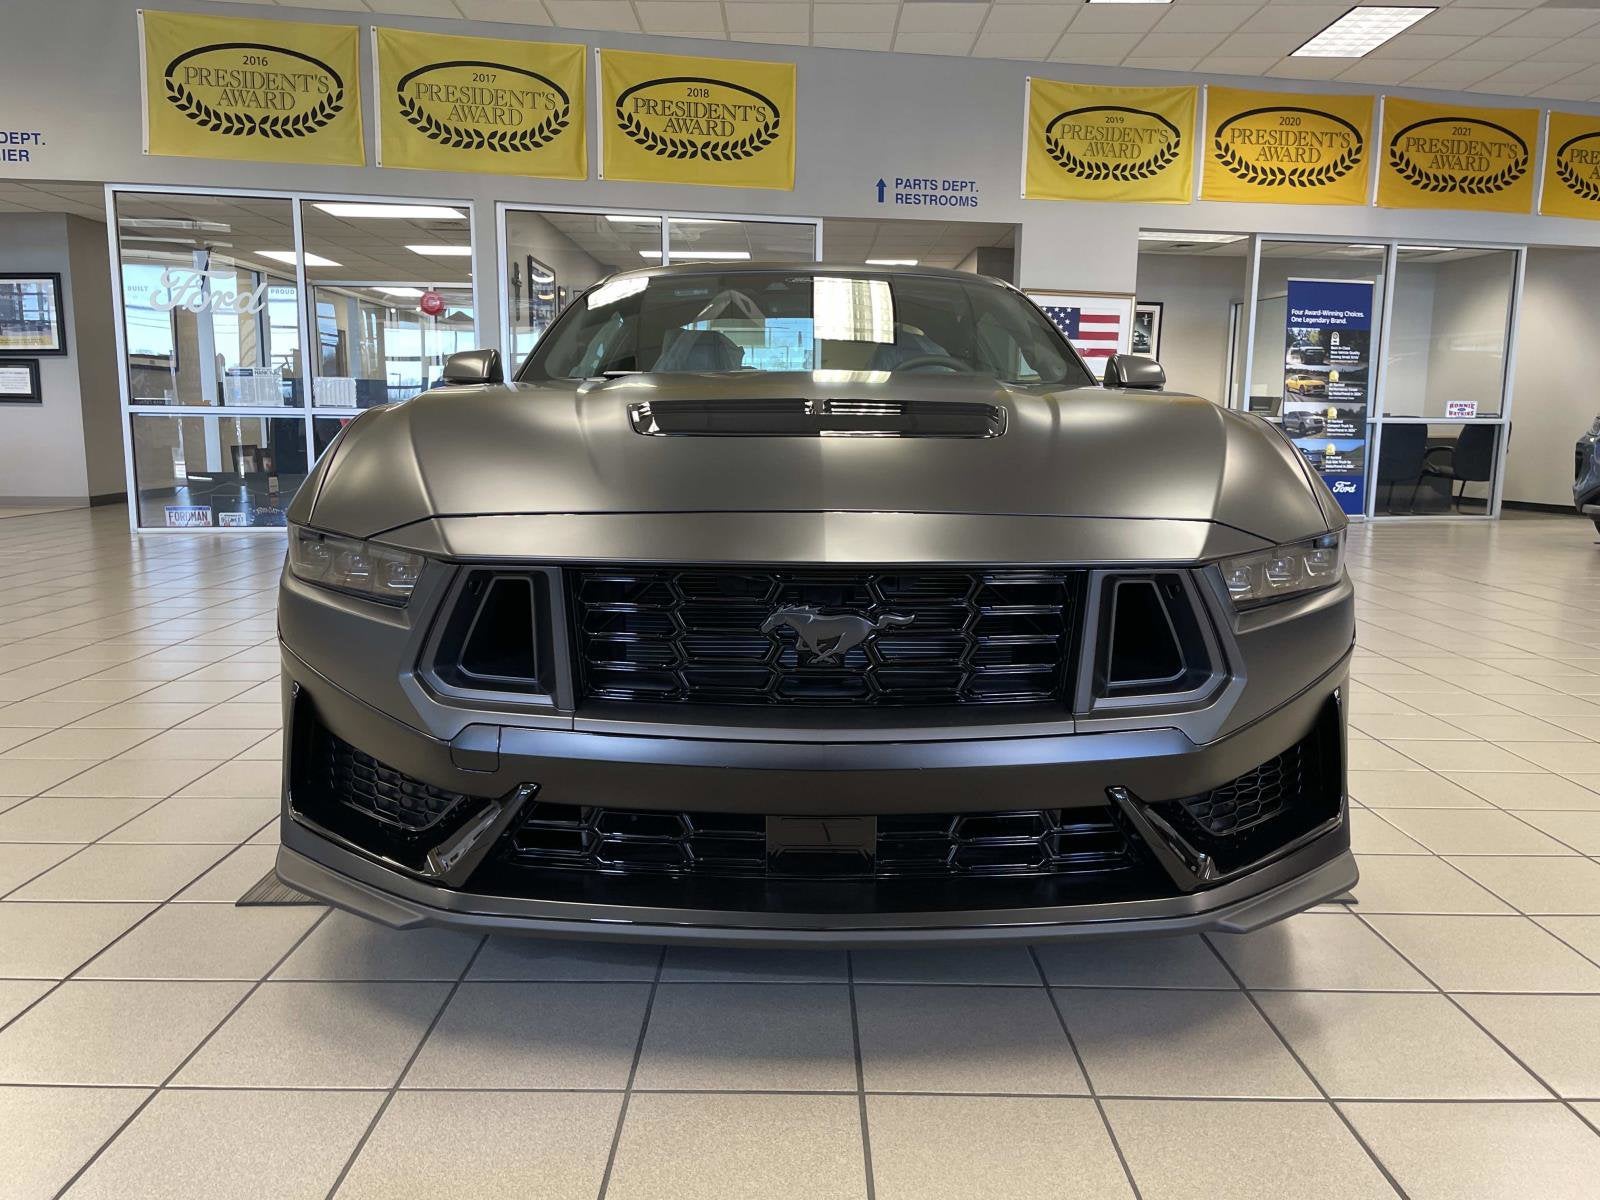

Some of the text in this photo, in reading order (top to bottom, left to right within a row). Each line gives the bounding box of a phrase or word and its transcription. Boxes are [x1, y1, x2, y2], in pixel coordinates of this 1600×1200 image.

[243, 55, 268, 66] 2016
[184, 66, 330, 94] PRESIDENT'S
[472, 72, 497, 83] 2017
[216, 88, 296, 111] AWARD
[414, 82, 556, 111] PRESIDENT'S
[686, 87, 710, 98] 2018
[446, 104, 523, 126] AWARD
[633, 97, 767, 123] PRESIDENT'S
[662, 117, 735, 137] AWARD
[1105, 116, 1125, 124] 2019
[1279, 116, 1302, 126] 2020
[1059, 123, 1169, 145] PRESIDENT'S
[1229, 127, 1352, 149] PRESIDENT'S
[1451, 126, 1471, 136] 2021
[1082, 142, 1142, 160] AWARD
[1255, 146, 1322, 164] AWARD
[1405, 136, 1518, 160] PRESIDENT'S
[1428, 154, 1490, 172] AWARD
[895, 177, 979, 193] PARTS DEPT.
[895, 193, 978, 208] RESTROOMS
[150, 267, 268, 314] Ford
[1303, 317, 1330, 325] Legendary
[1304, 309, 1343, 318] Award-Winning
[1332, 481, 1357, 493] Ford
[168, 511, 208, 522] FORDMAN
